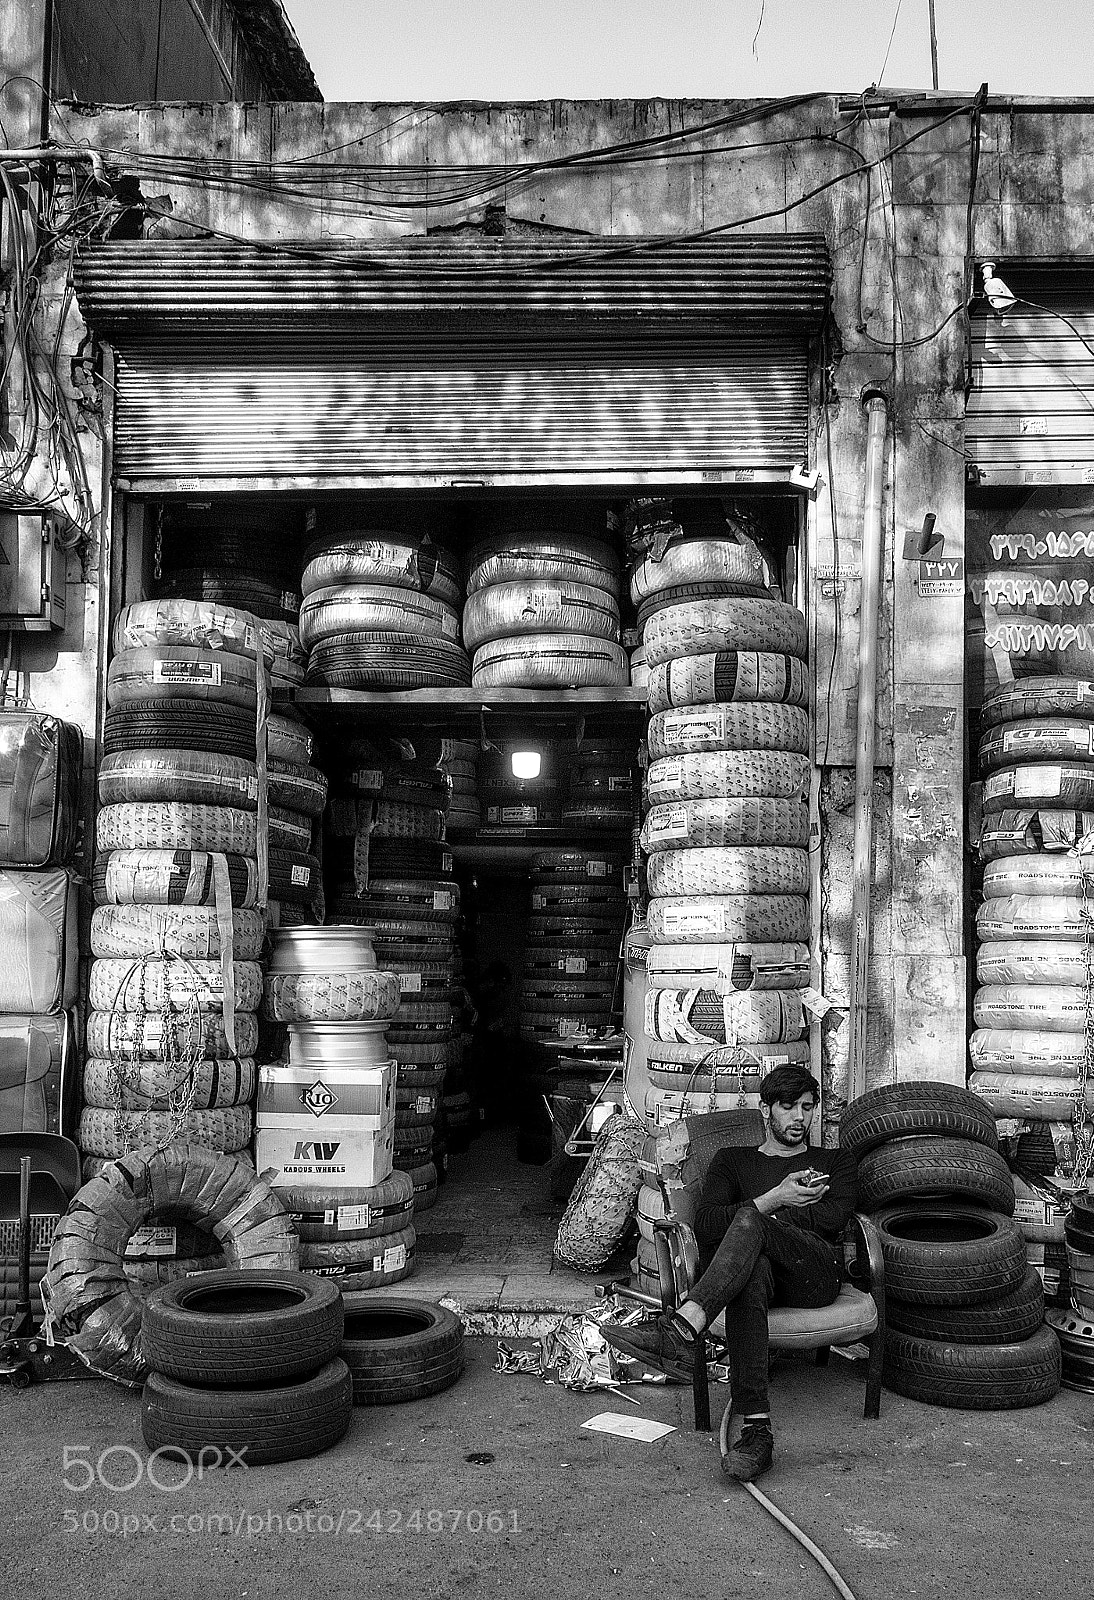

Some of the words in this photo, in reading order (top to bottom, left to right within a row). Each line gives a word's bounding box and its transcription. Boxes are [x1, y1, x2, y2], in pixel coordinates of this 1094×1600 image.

[925, 561, 959, 577] ۳۲۷
[970, 579, 1094, 605] ۳۳۹۳۱۵۸۴
[651, 1062, 683, 1072] FALKEN
[293, 1141, 341, 1161] KW
